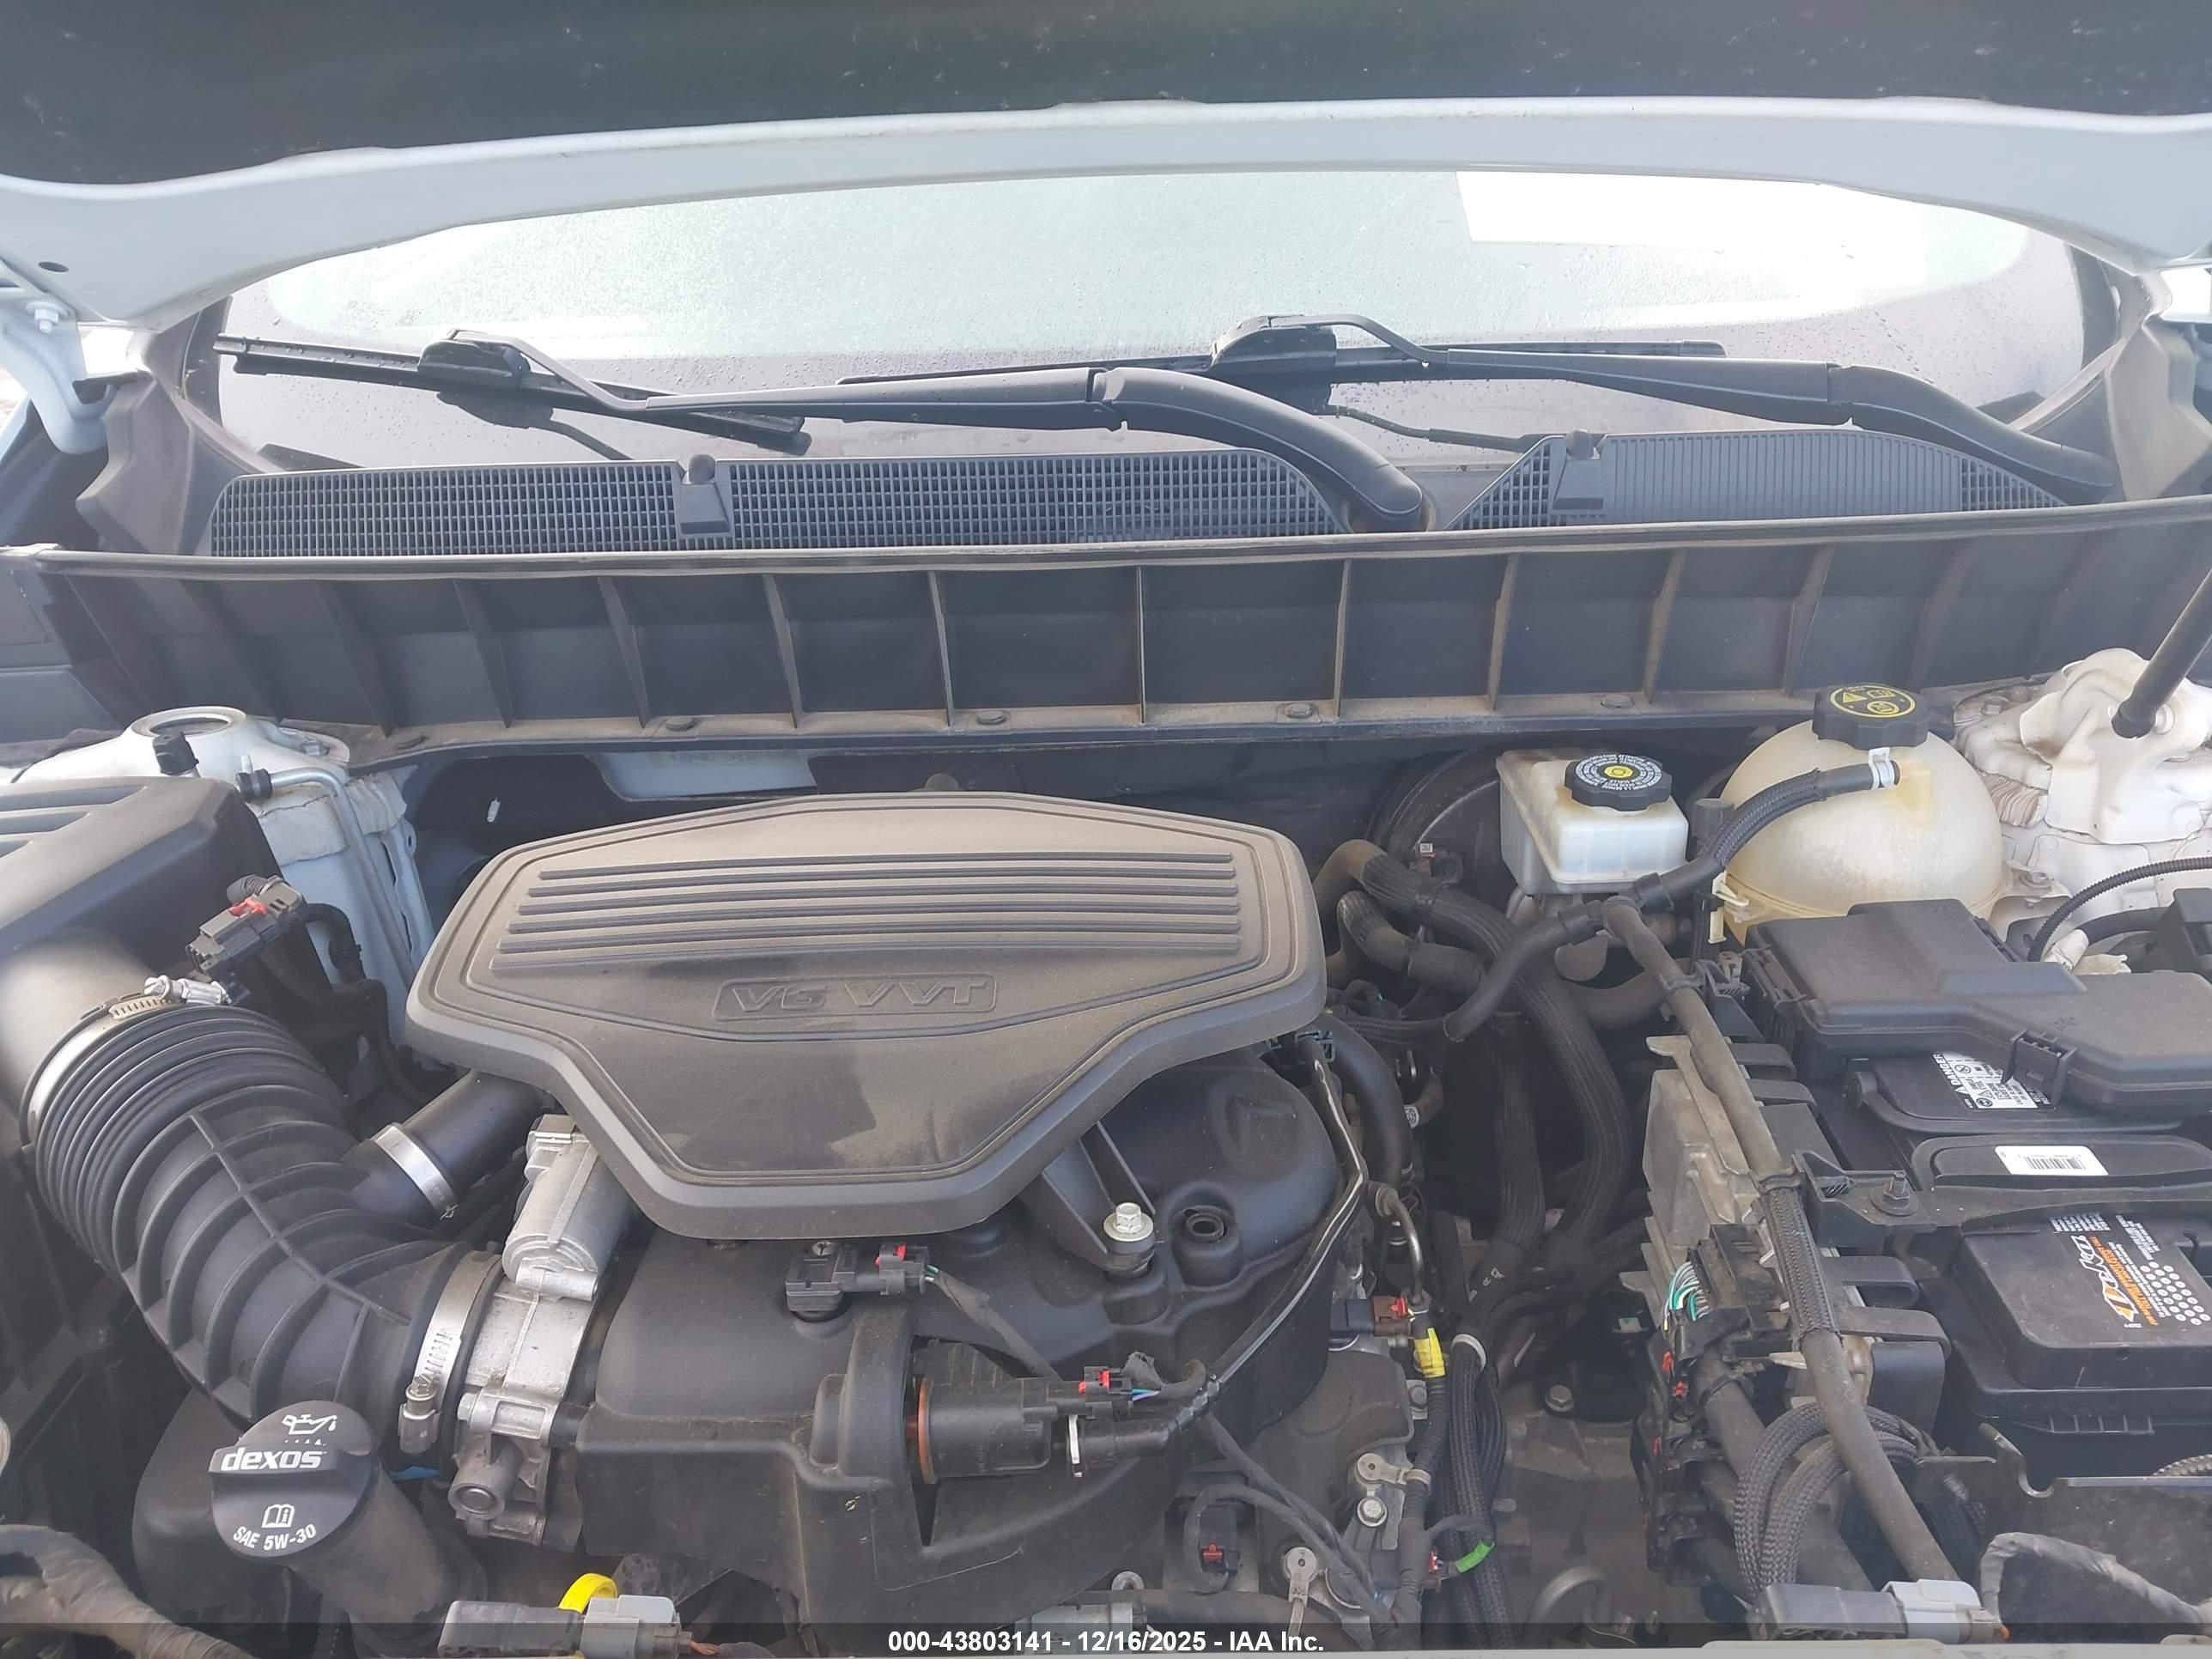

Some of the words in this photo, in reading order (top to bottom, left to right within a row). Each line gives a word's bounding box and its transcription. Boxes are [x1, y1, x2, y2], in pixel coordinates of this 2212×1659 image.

[731, 984, 829, 1012] V6
[843, 981, 986, 1008] VVT
[1932, 1051, 1962, 1086] DANGER
[221, 1447, 323, 1471] dexos
[233, 1526, 261, 1548] SAE
[263, 1523, 317, 1551] 5W-30
